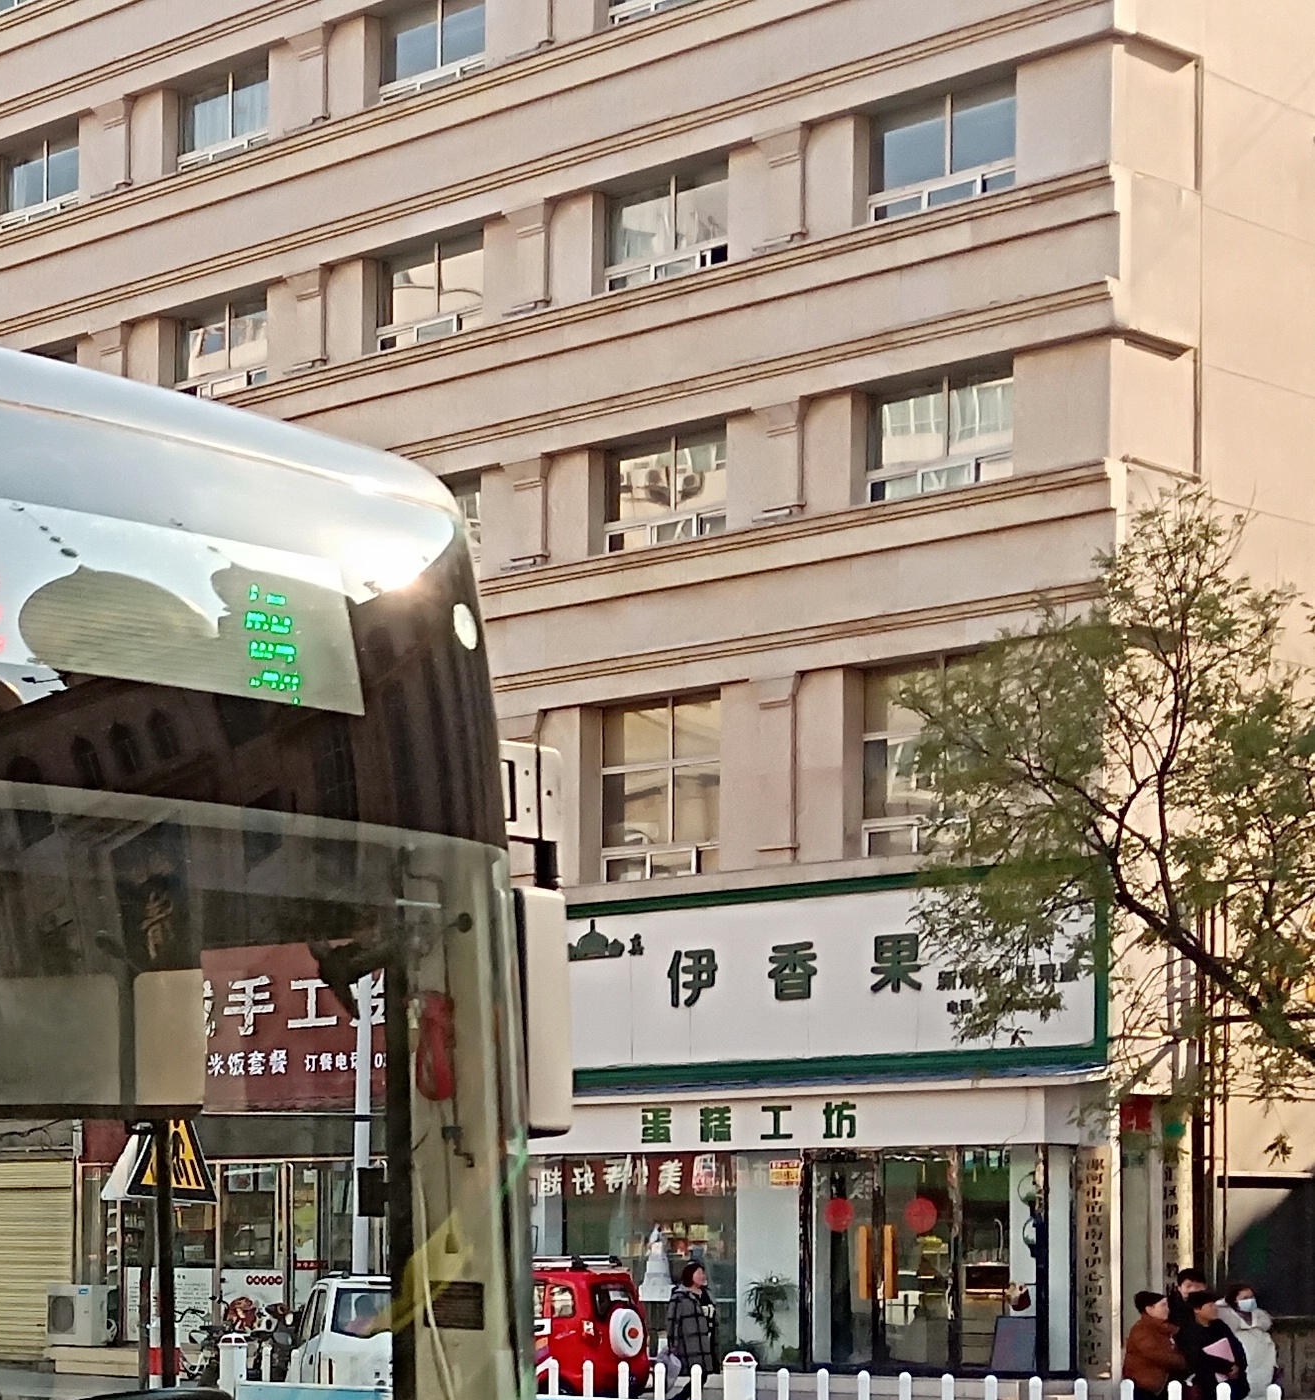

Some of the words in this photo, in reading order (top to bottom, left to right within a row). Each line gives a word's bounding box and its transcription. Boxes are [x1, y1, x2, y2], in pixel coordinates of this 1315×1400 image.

[667, 933, 922, 1008] 伊香果
[641, 1101, 857, 1144] 蛋糕工坊
